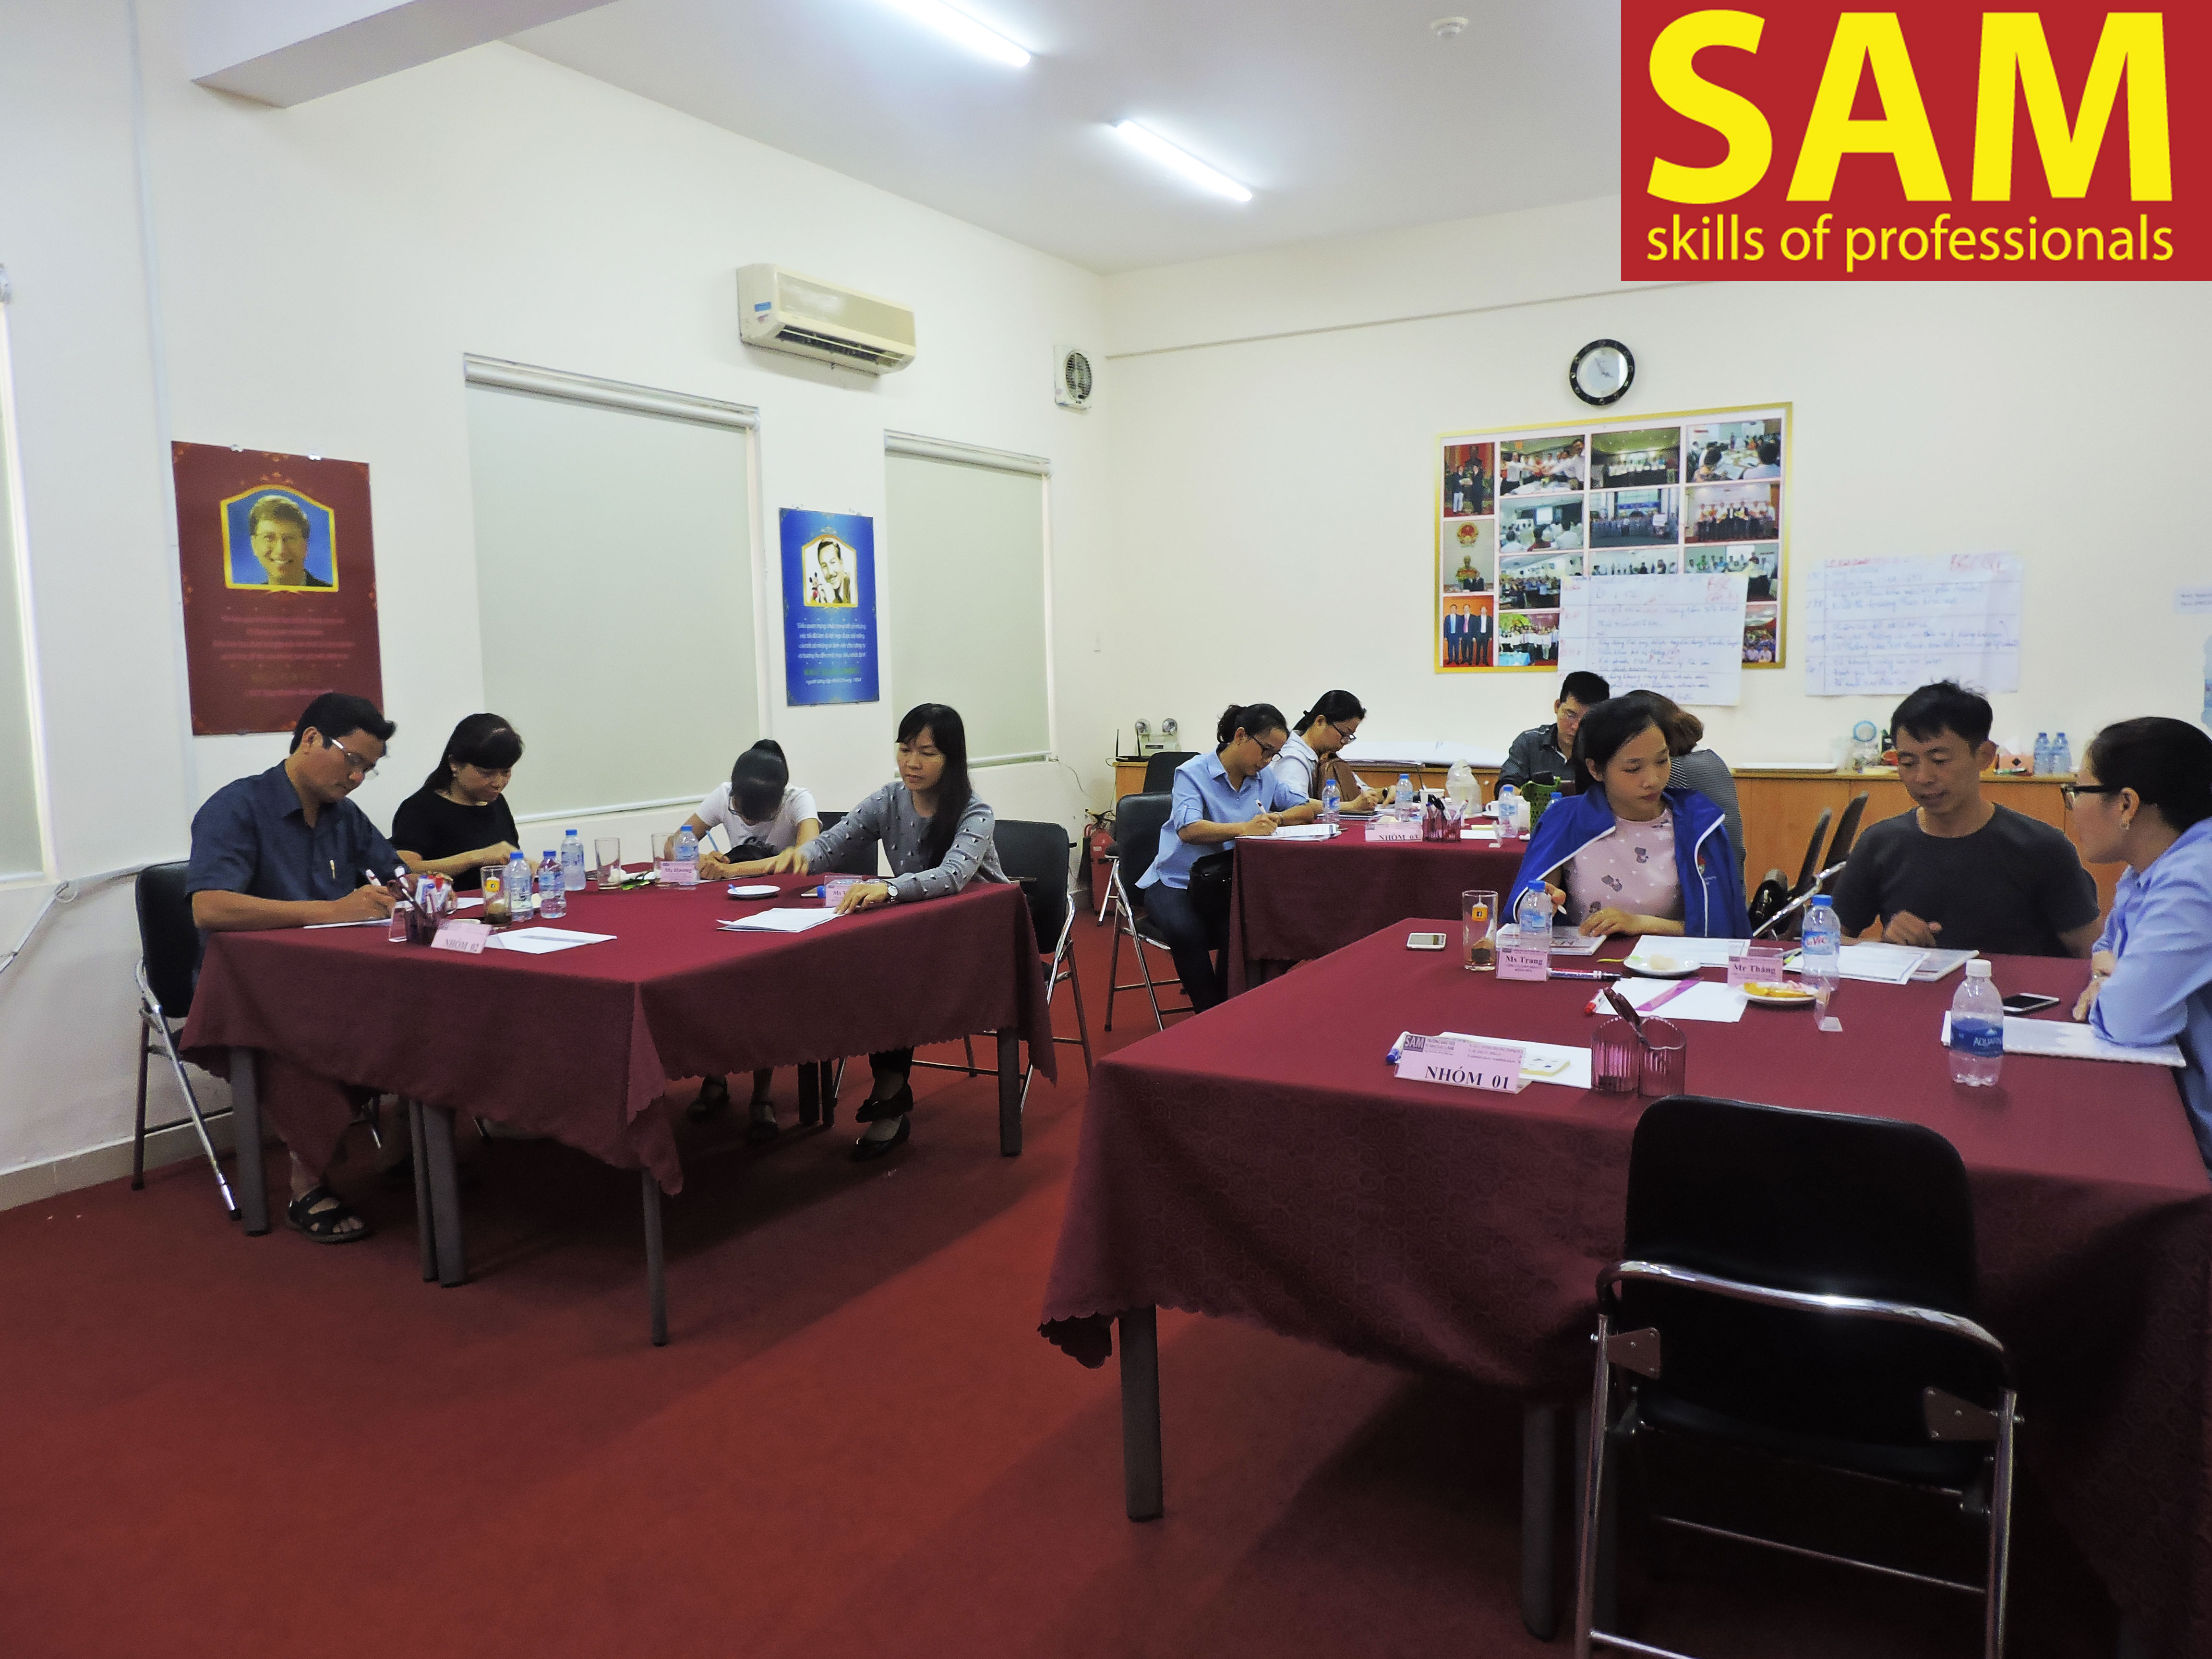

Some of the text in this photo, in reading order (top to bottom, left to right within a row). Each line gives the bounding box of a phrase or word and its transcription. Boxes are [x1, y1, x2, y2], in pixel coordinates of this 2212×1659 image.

[1519, 957, 1542, 965] Trang
[1405, 1035, 1425, 1048] SAM
[1425, 1066, 1509, 1089] NHÓM 01
